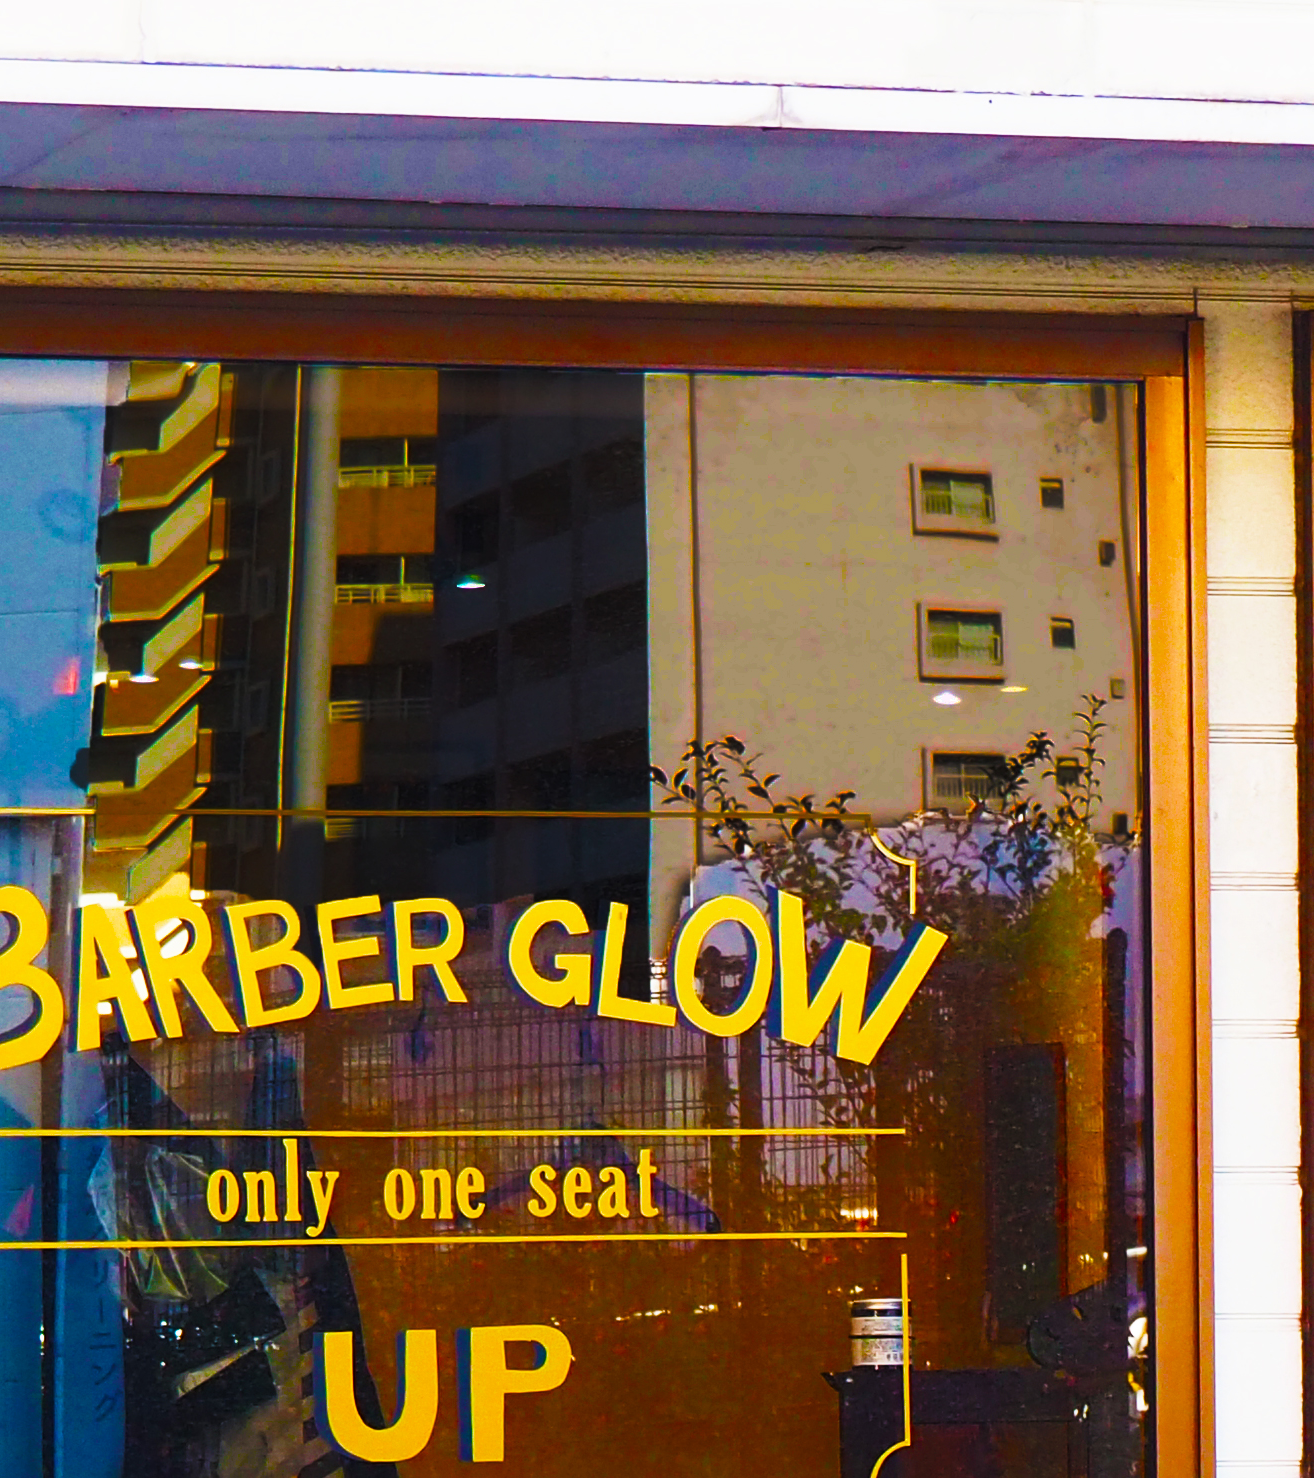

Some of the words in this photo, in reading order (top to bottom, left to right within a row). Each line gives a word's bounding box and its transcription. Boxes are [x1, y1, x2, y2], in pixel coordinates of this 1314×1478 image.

[506, 884, 948, 1066] GLOW
[205, 1137, 340, 1235] only
[383, 1164, 487, 1221] one
[527, 1148, 661, 1220] seat
[314, 1323, 576, 1463] UP
